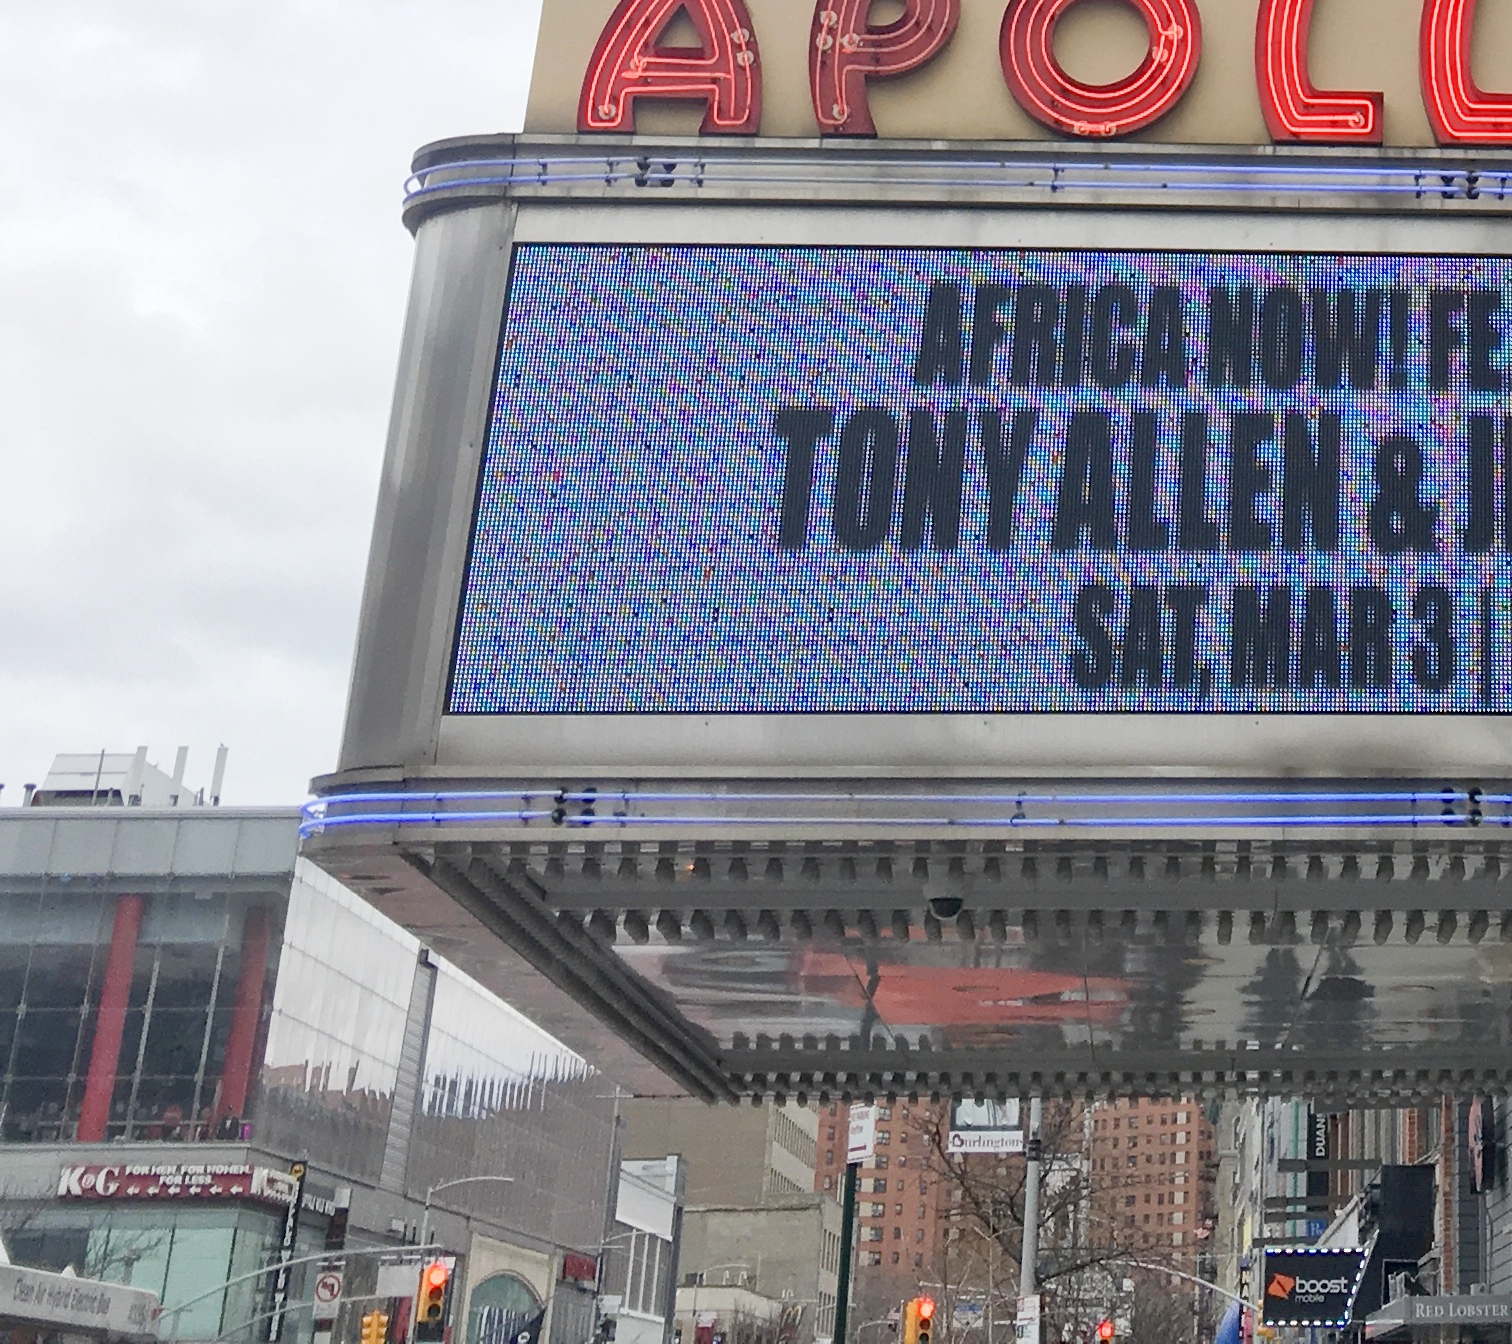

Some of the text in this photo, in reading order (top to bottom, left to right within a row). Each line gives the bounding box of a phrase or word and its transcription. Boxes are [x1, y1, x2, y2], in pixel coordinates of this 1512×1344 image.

[914, 279, 1187, 390] AFRICA
[1210, 286, 1414, 392] NOW!
[775, 407, 1038, 552] TONY
[1052, 409, 1341, 553] ALLEN
[1369, 434, 1438, 555] &
[1069, 584, 1210, 696] SAT,
[1230, 585, 1393, 691] MAR
[1411, 585, 1454, 693] 3
[1295, 1276, 1349, 1293] boost
[1295, 1295, 1325, 1303] mobile
[1415, 1303, 1445, 1318] RED
[1449, 1302, 1510, 1318] LOBSTER
